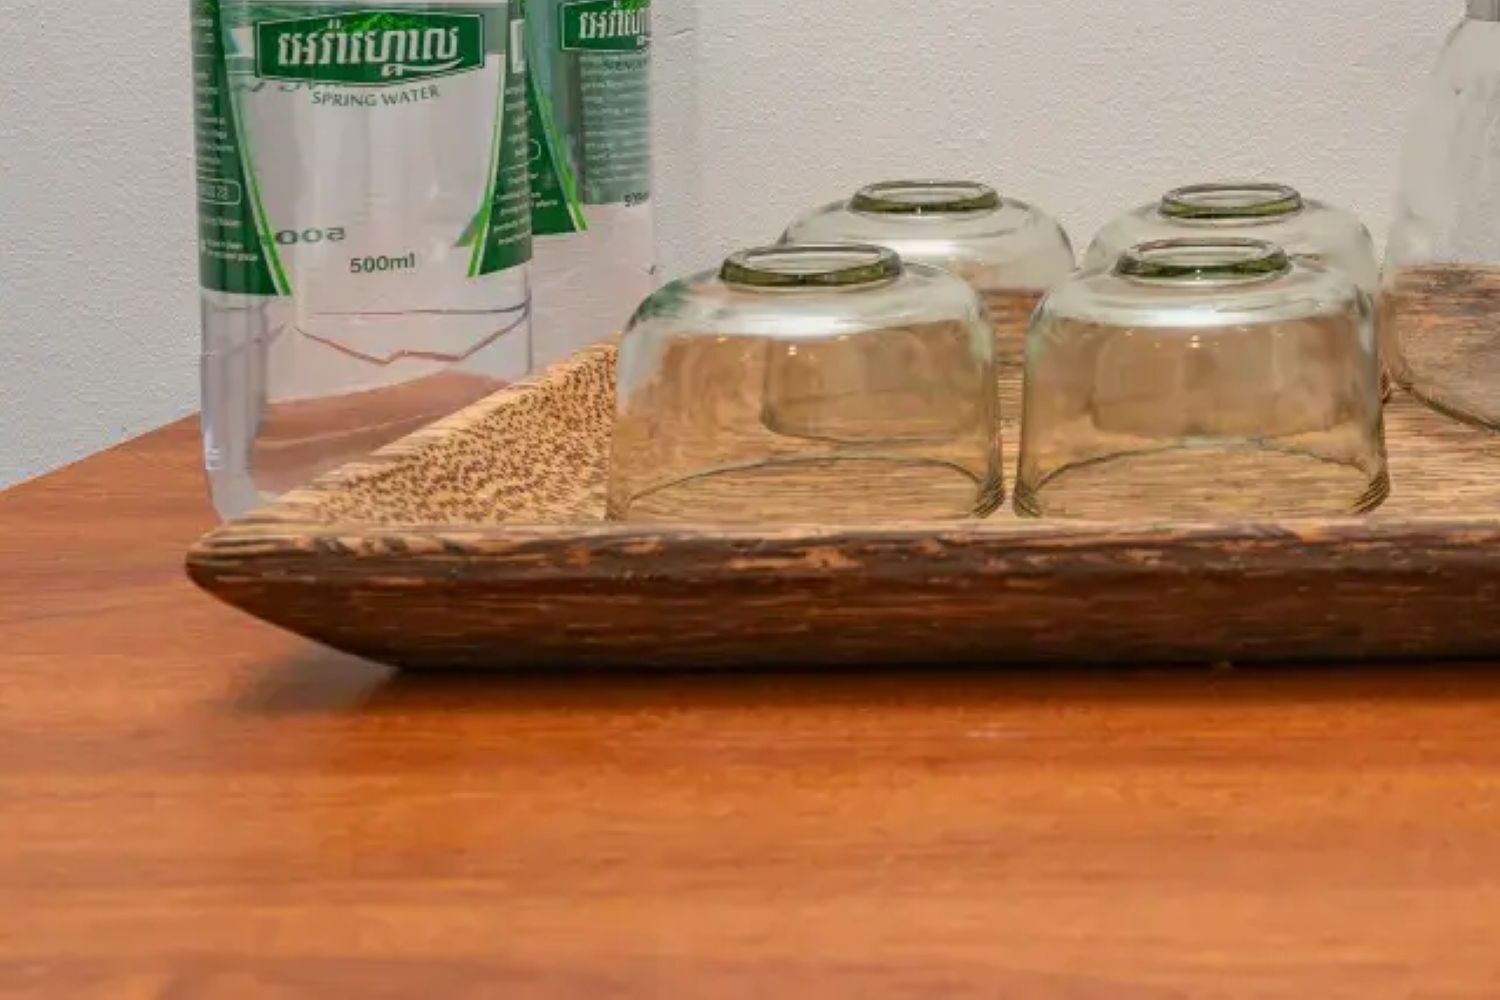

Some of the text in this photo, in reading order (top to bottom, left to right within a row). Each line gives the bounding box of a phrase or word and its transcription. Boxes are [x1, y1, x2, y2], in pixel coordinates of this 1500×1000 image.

[312, 85, 441, 107] SPRING WATER
[350, 253, 416, 274] 500ml
